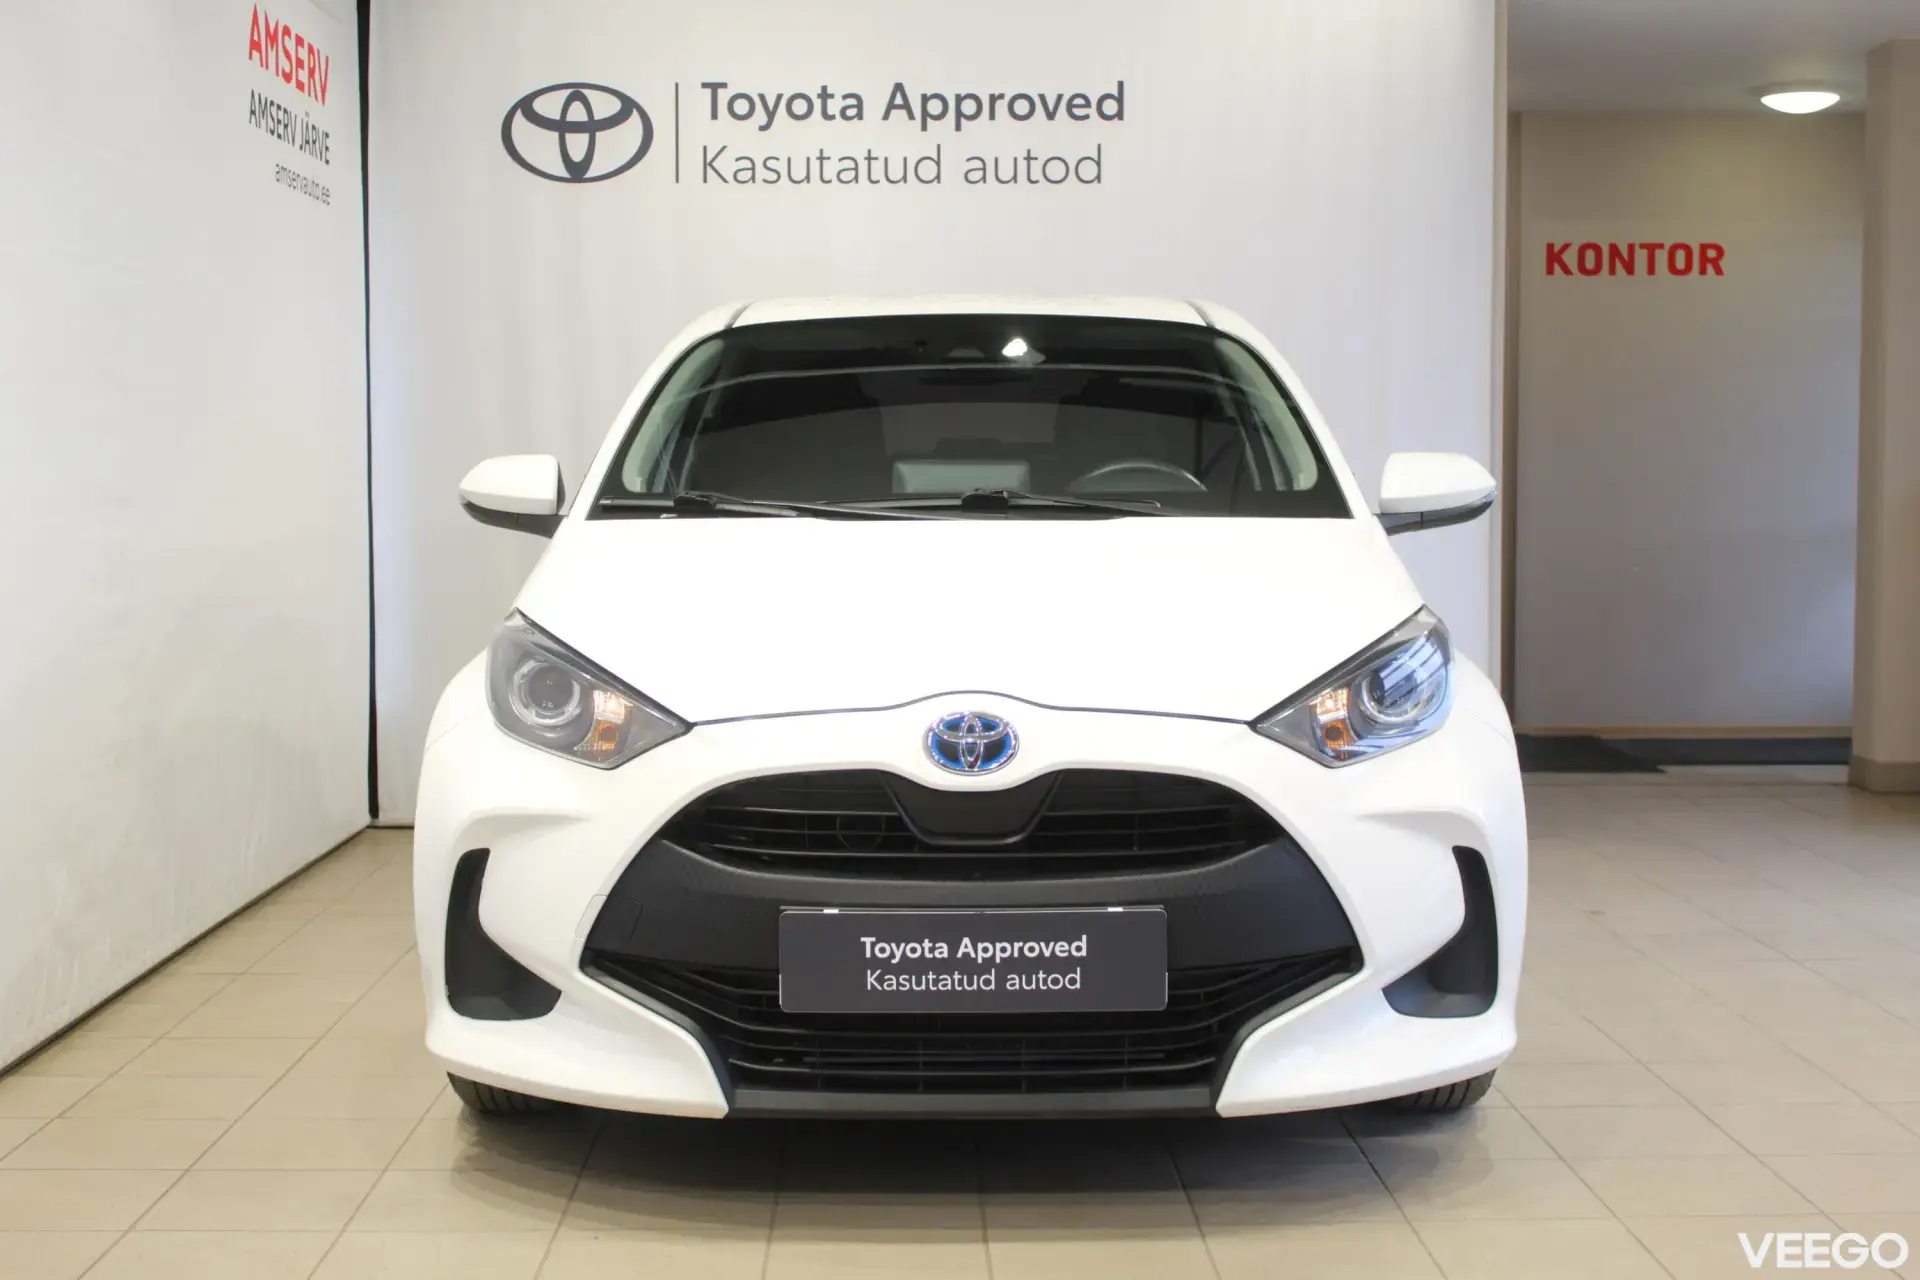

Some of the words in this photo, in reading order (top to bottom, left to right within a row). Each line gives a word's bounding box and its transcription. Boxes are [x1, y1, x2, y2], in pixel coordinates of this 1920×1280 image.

[248, 3, 329, 107] AMSERV
[700, 82, 865, 131] Toyota
[882, 80, 1126, 131] Approved
[249, 89, 298, 147] AMSERV
[299, 110, 330, 165] JÄRVE
[275, 163, 330, 206] amservauto.ee
[702, 143, 942, 185] Kasutatud
[964, 143, 1102, 185] autod
[1545, 242, 1725, 277] KONTOR
[861, 936, 949, 963] Toyota
[956, 934, 1087, 963] Approved
[866, 969, 995, 991] Kasutatud
[1006, 967, 1081, 990] autod
